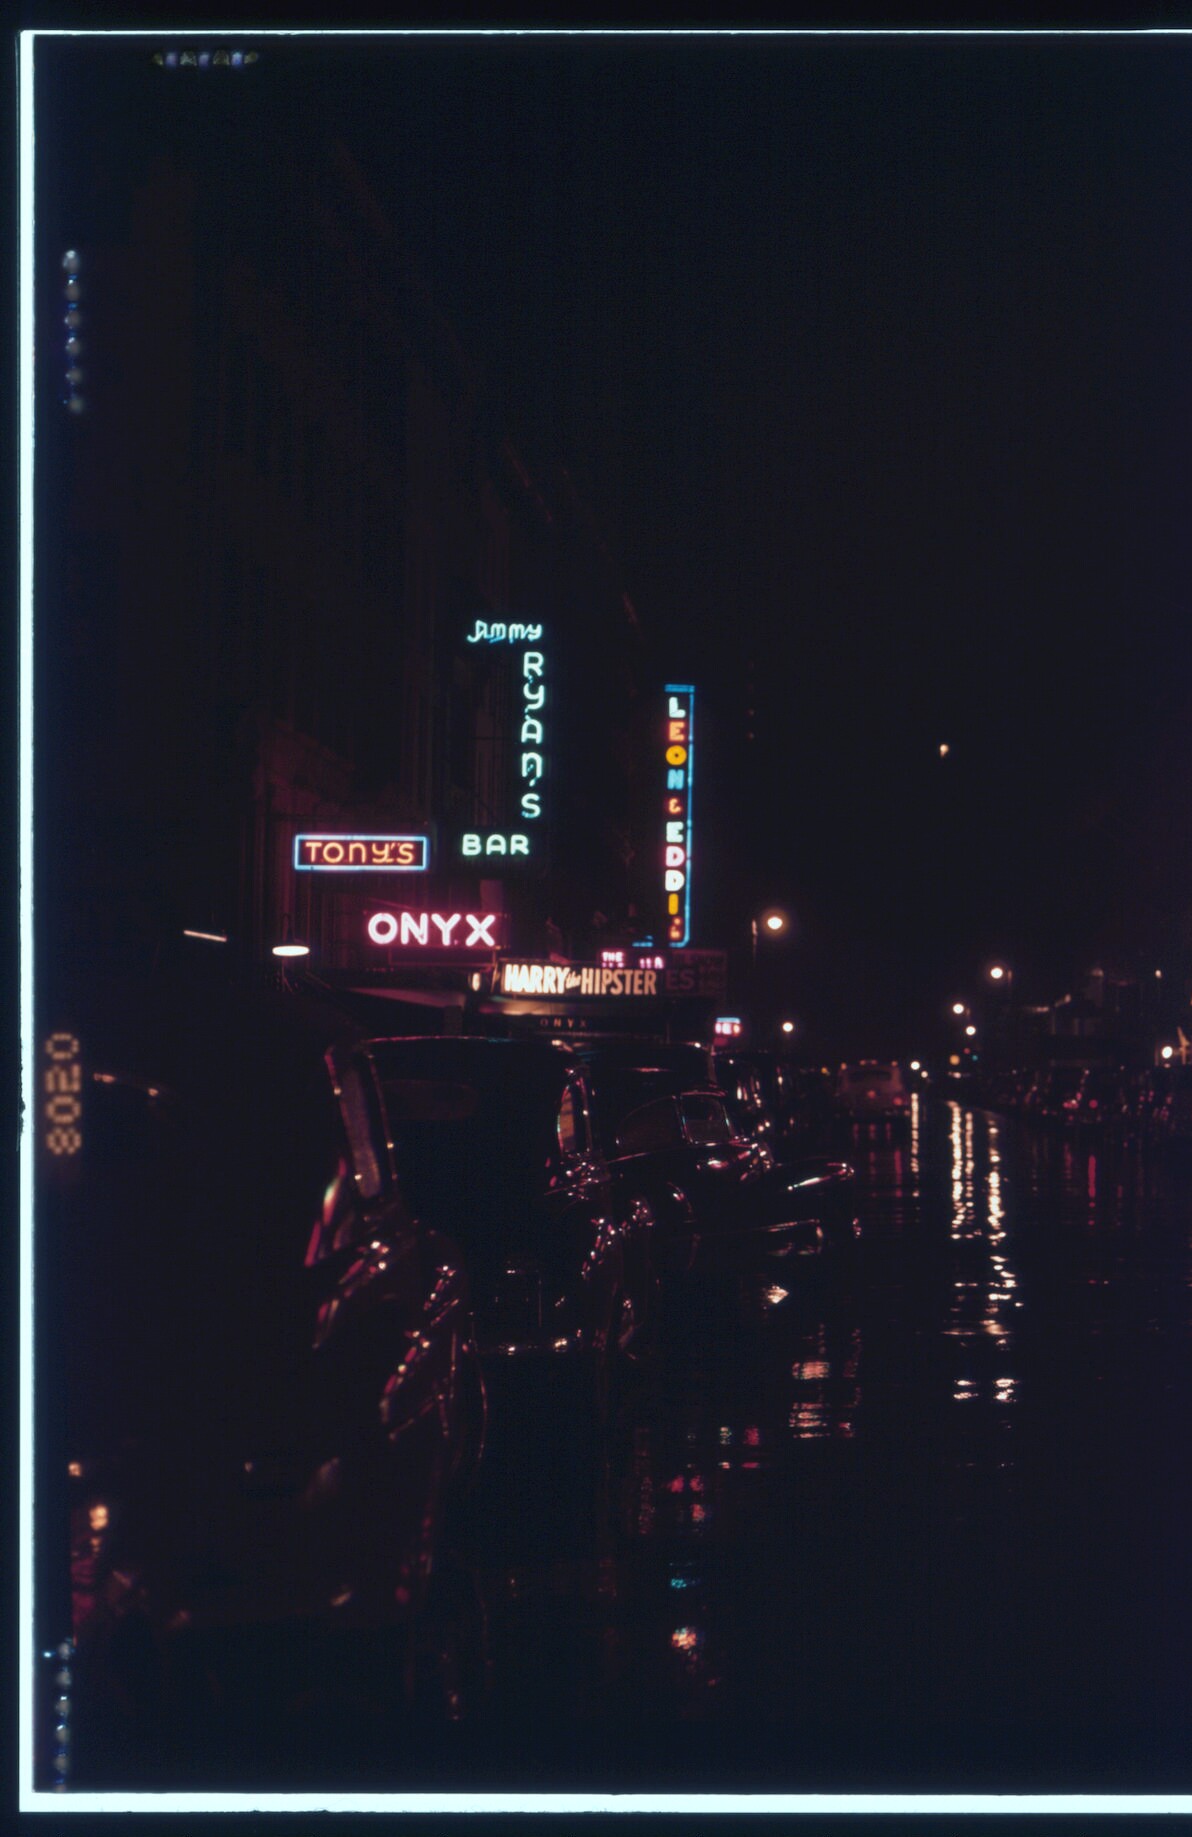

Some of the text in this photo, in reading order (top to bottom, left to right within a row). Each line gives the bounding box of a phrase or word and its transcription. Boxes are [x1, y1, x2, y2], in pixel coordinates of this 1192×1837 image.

[665, 696, 687, 790] LEON
[461, 833, 530, 856] BAR
[367, 912, 497, 946] ONYX
[504, 963, 567, 995] HARRY
[581, 967, 657, 995] HIPSTER
